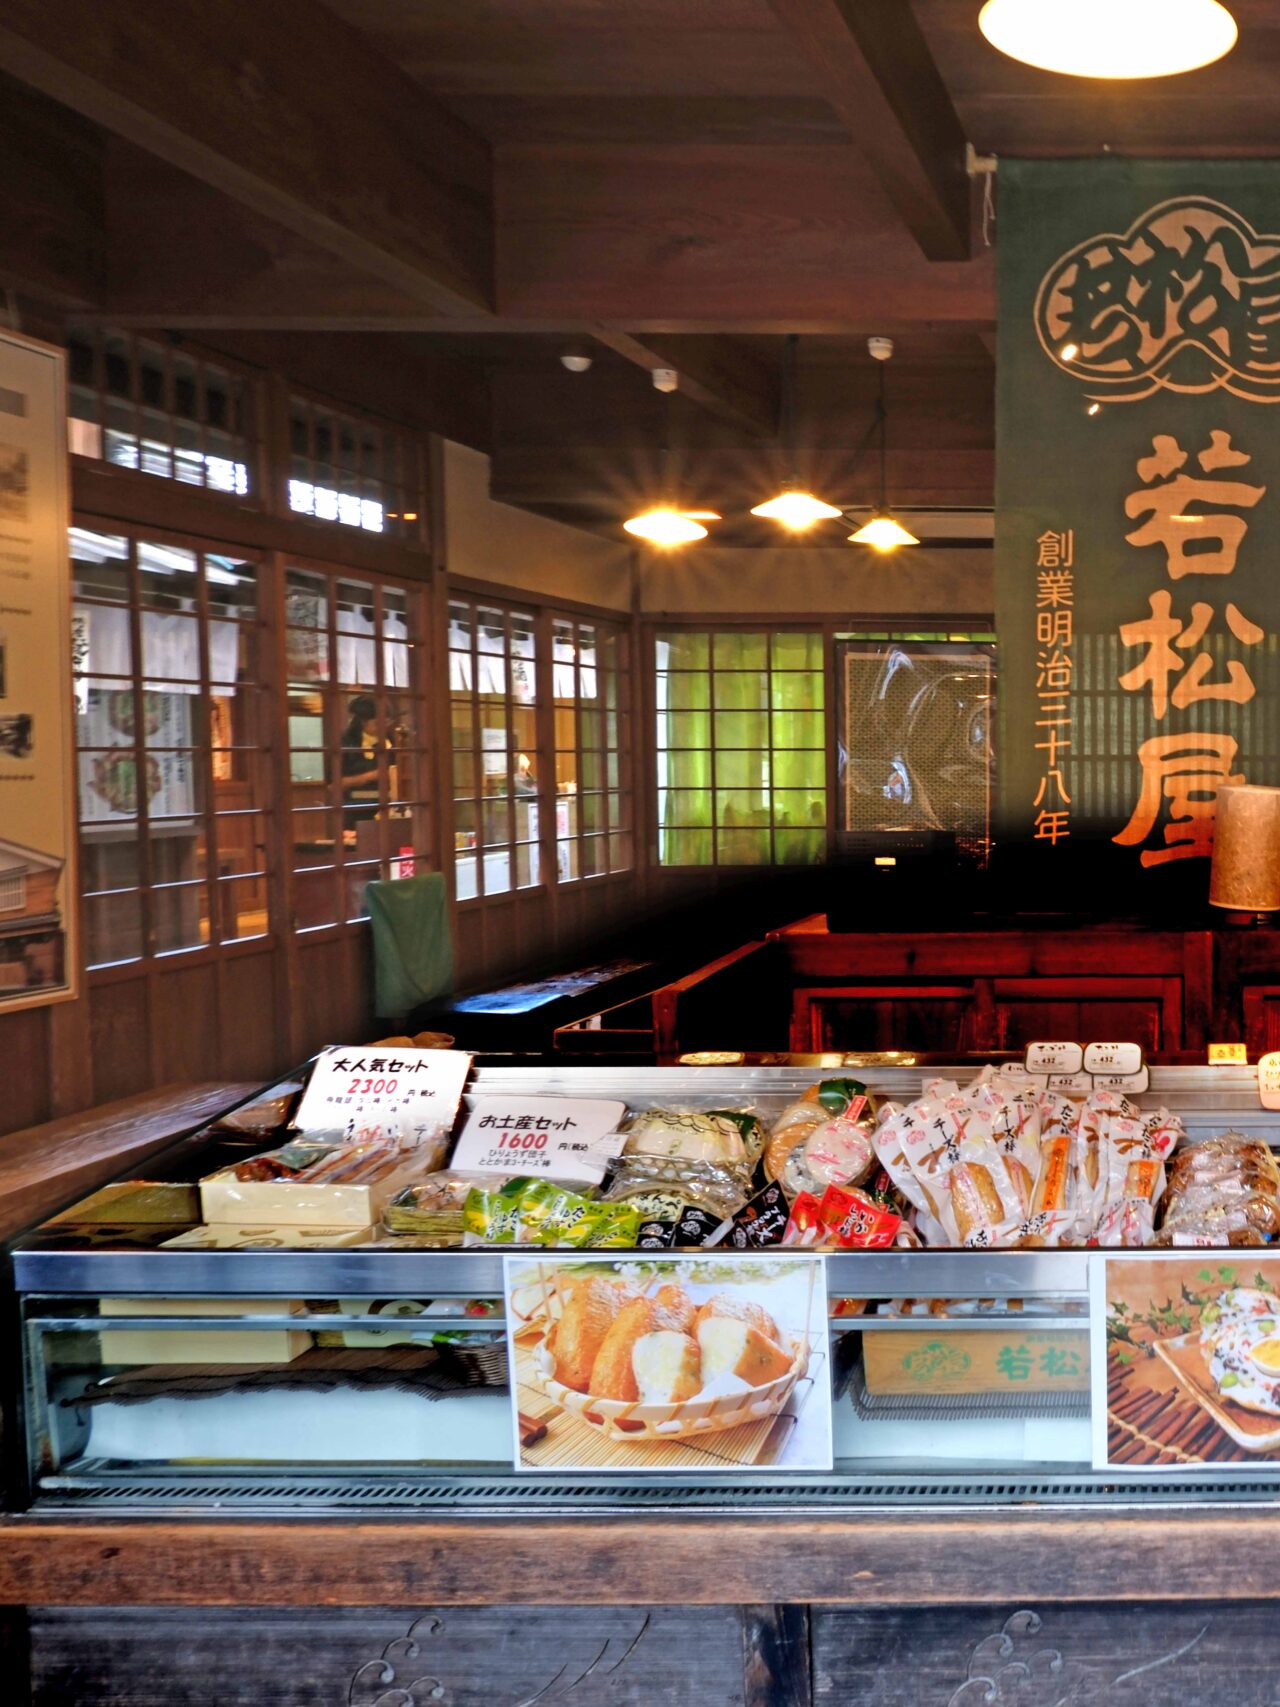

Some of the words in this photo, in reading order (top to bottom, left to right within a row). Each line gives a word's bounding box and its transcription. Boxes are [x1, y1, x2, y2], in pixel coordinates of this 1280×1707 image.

[1111, 429, 1267, 869] 若松屋
[1033, 529, 1074, 846] 創業明治三十八年
[332, 1057, 429, 1074] 大人気セット
[347, 1078, 398, 1094] 2300
[478, 1114, 578, 1131] お土産セット
[498, 1132, 549, 1150] 1600
[996, 1344, 1090, 1382] 若松
